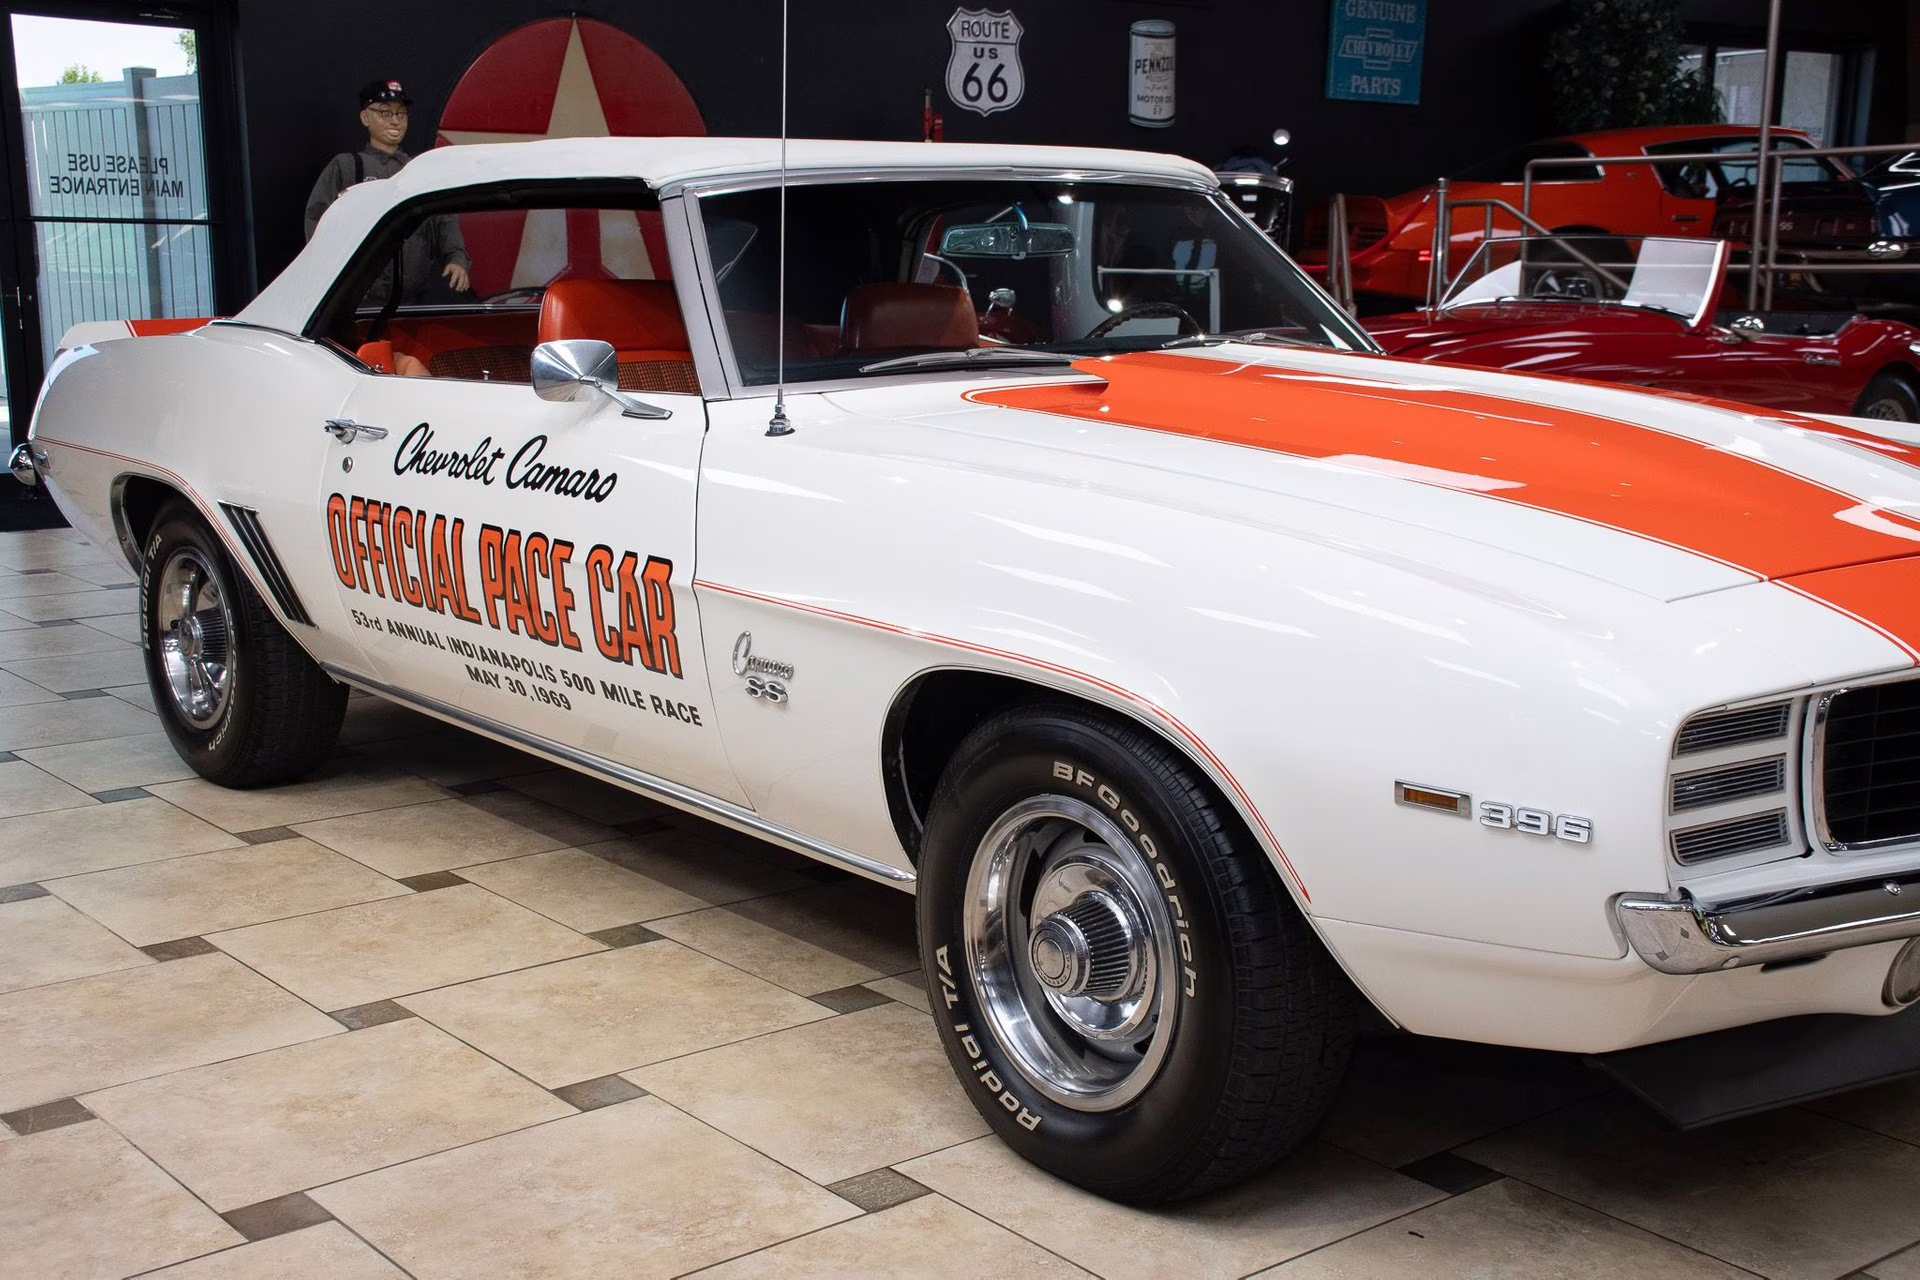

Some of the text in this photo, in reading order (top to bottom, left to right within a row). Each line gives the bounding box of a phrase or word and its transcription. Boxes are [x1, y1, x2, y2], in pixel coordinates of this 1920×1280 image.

[961, 21, 1010, 39] ROUTE
[1345, 0, 1416, 23] GENUINE
[1345, 39, 1412, 58] CHEVROLET
[962, 62, 1008, 103] 66
[1350, 75, 1401, 96] PARTS
[394, 423, 618, 503] Chevrolet Camaro
[148, 534, 163, 561] T/A
[327, 492, 683, 680] OFFICIAL PACE CAR
[351, 609, 703, 727] 53rd ANNUAL INDIANAPOLIS 500 MILE RACE
[733, 631, 794, 680] Camaro
[464, 663, 502, 694] MAY
[745, 676, 788, 704] SS
[1479, 800, 1593, 844] 396
[1052, 760, 1198, 998] BFGoodrich
[935, 944, 959, 1010] T/A
